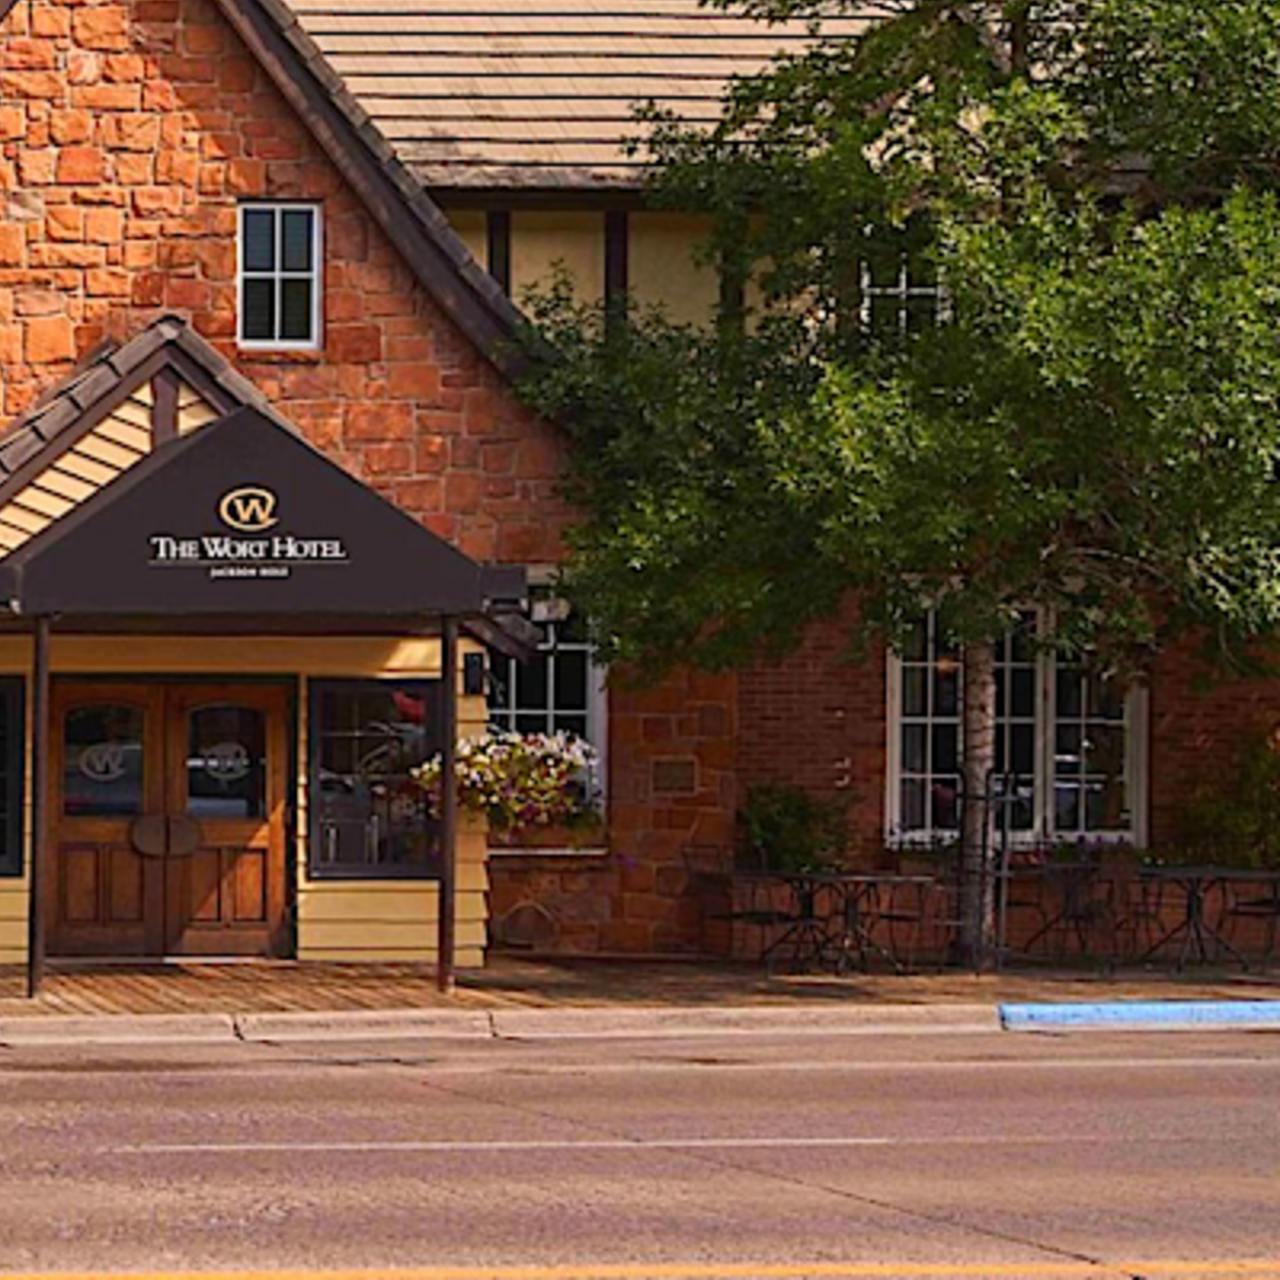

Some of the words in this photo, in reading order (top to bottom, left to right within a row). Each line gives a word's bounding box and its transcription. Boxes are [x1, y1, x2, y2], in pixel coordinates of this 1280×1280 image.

[151, 536, 200, 559] THE
[201, 536, 269, 559] WORT
[272, 536, 346, 559] HOTEL
